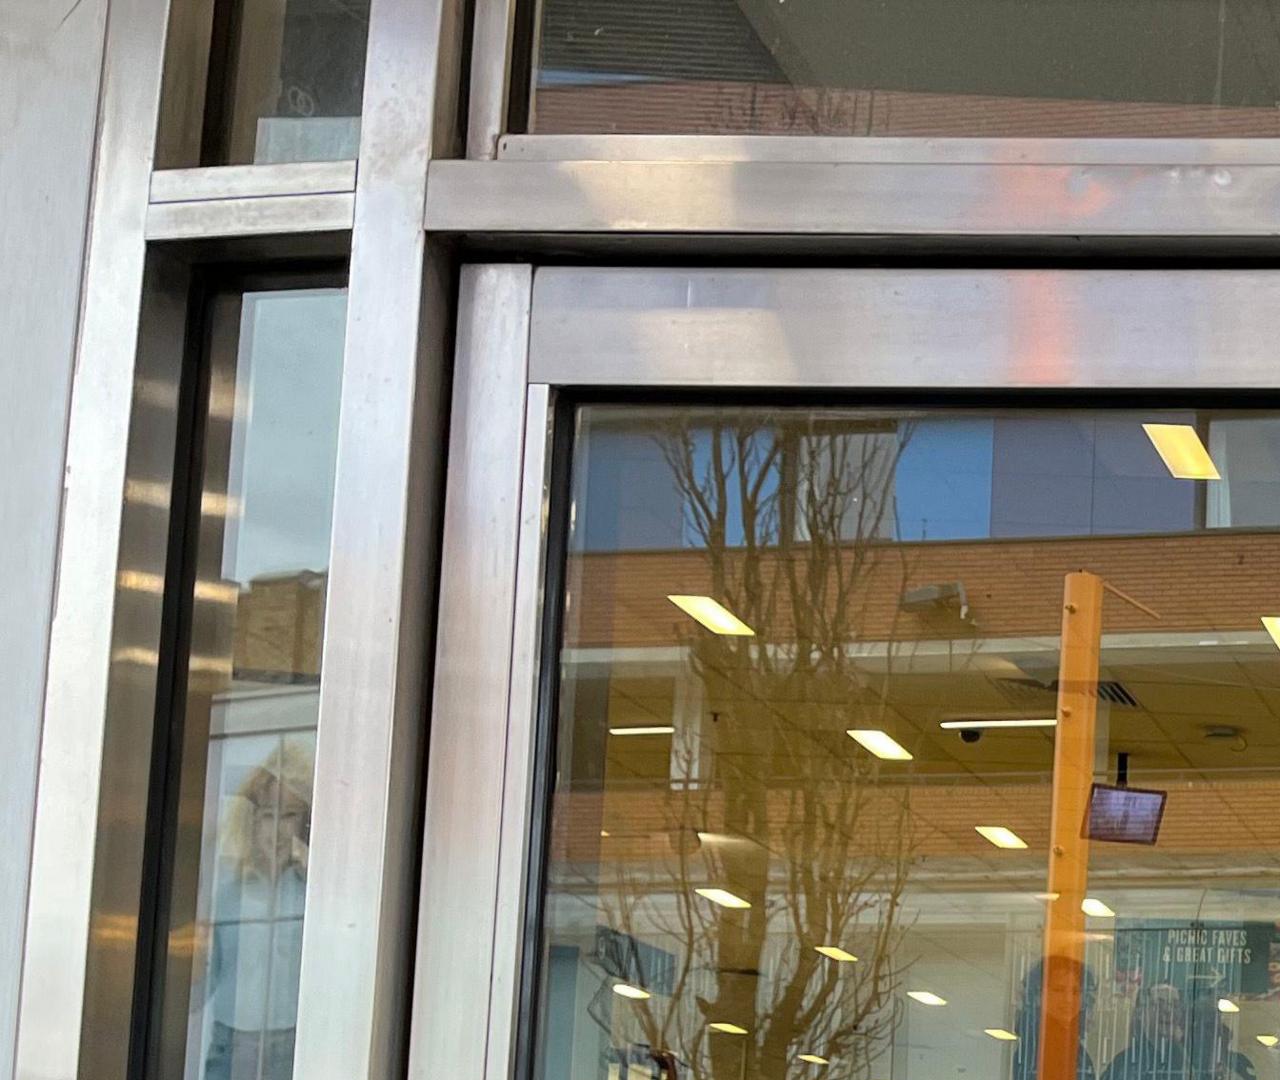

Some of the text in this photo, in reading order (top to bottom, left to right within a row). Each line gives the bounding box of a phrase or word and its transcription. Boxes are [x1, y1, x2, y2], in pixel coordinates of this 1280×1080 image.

[1212, 929, 1247, 946] FAVES
[1177, 948, 1212, 963] GREAT
[1217, 948, 1252, 964] GIFTS
